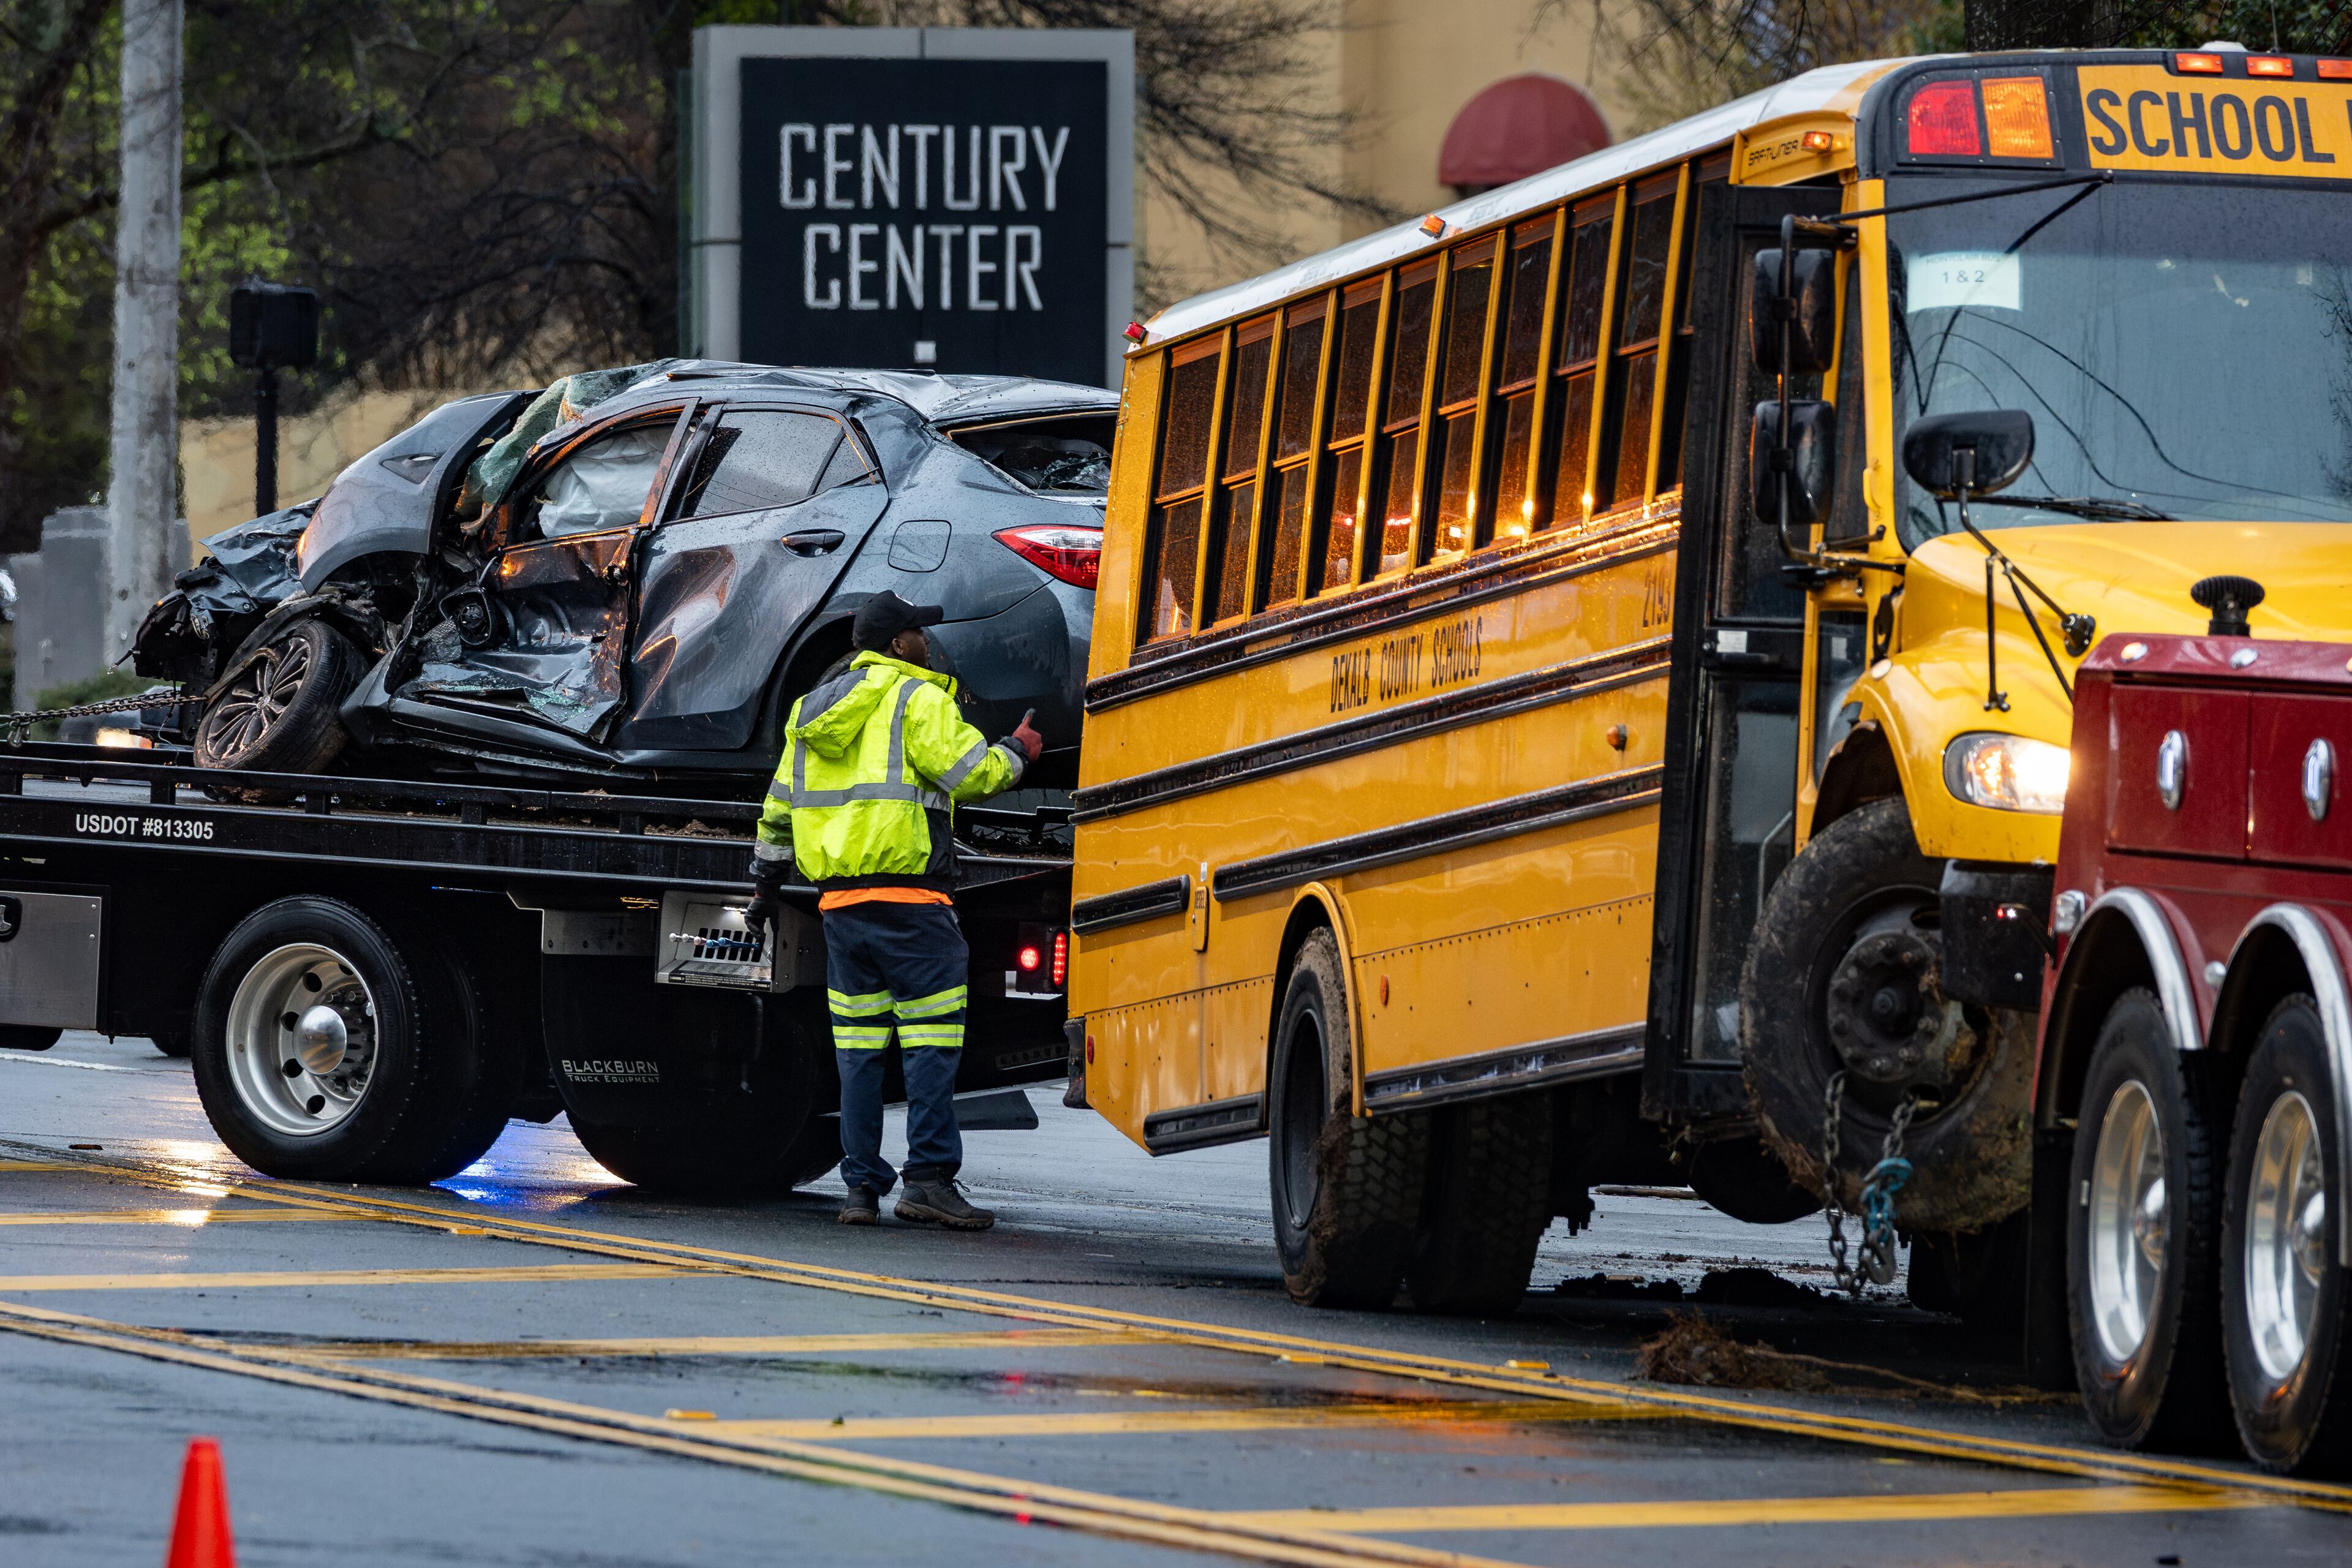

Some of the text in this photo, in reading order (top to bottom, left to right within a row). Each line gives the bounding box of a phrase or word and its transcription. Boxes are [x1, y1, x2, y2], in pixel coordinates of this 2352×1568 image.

[2086, 88, 2335, 164] SCHOOL
[779, 124, 1070, 212] CENTURY
[804, 224, 1043, 311] CENTER
[1942, 270, 1985, 284] 1 & 2
[1330, 616, 1482, 714] DEKALB COUNTY SCHOOLS
[75, 813, 214, 840] USDOT #813305
[562, 1060, 659, 1073] BLACKBURN
